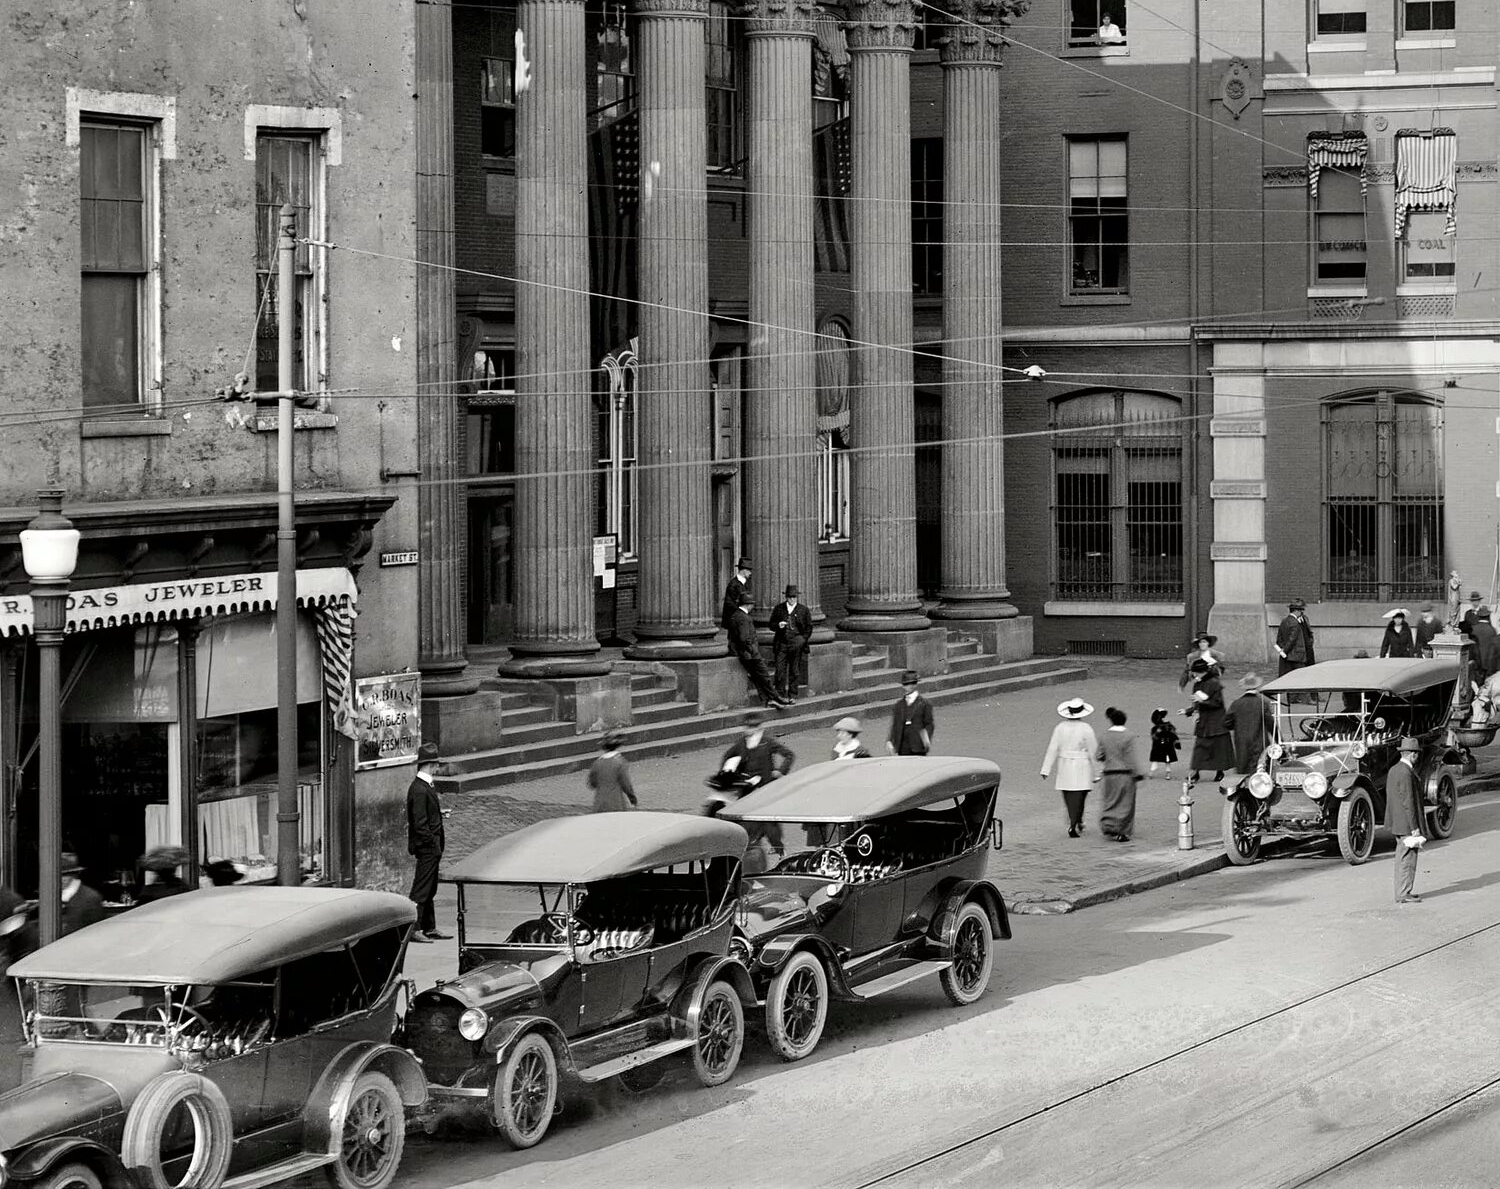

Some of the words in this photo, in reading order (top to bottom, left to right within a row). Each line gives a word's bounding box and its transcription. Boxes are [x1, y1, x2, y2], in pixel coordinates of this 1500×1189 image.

[1418, 238, 1446, 249] COAL
[383, 554, 407, 562] MARKET
[3, 600, 28, 614] R.
[145, 577, 264, 602] JEWELER
[366, 712, 408, 730] JEWELER
